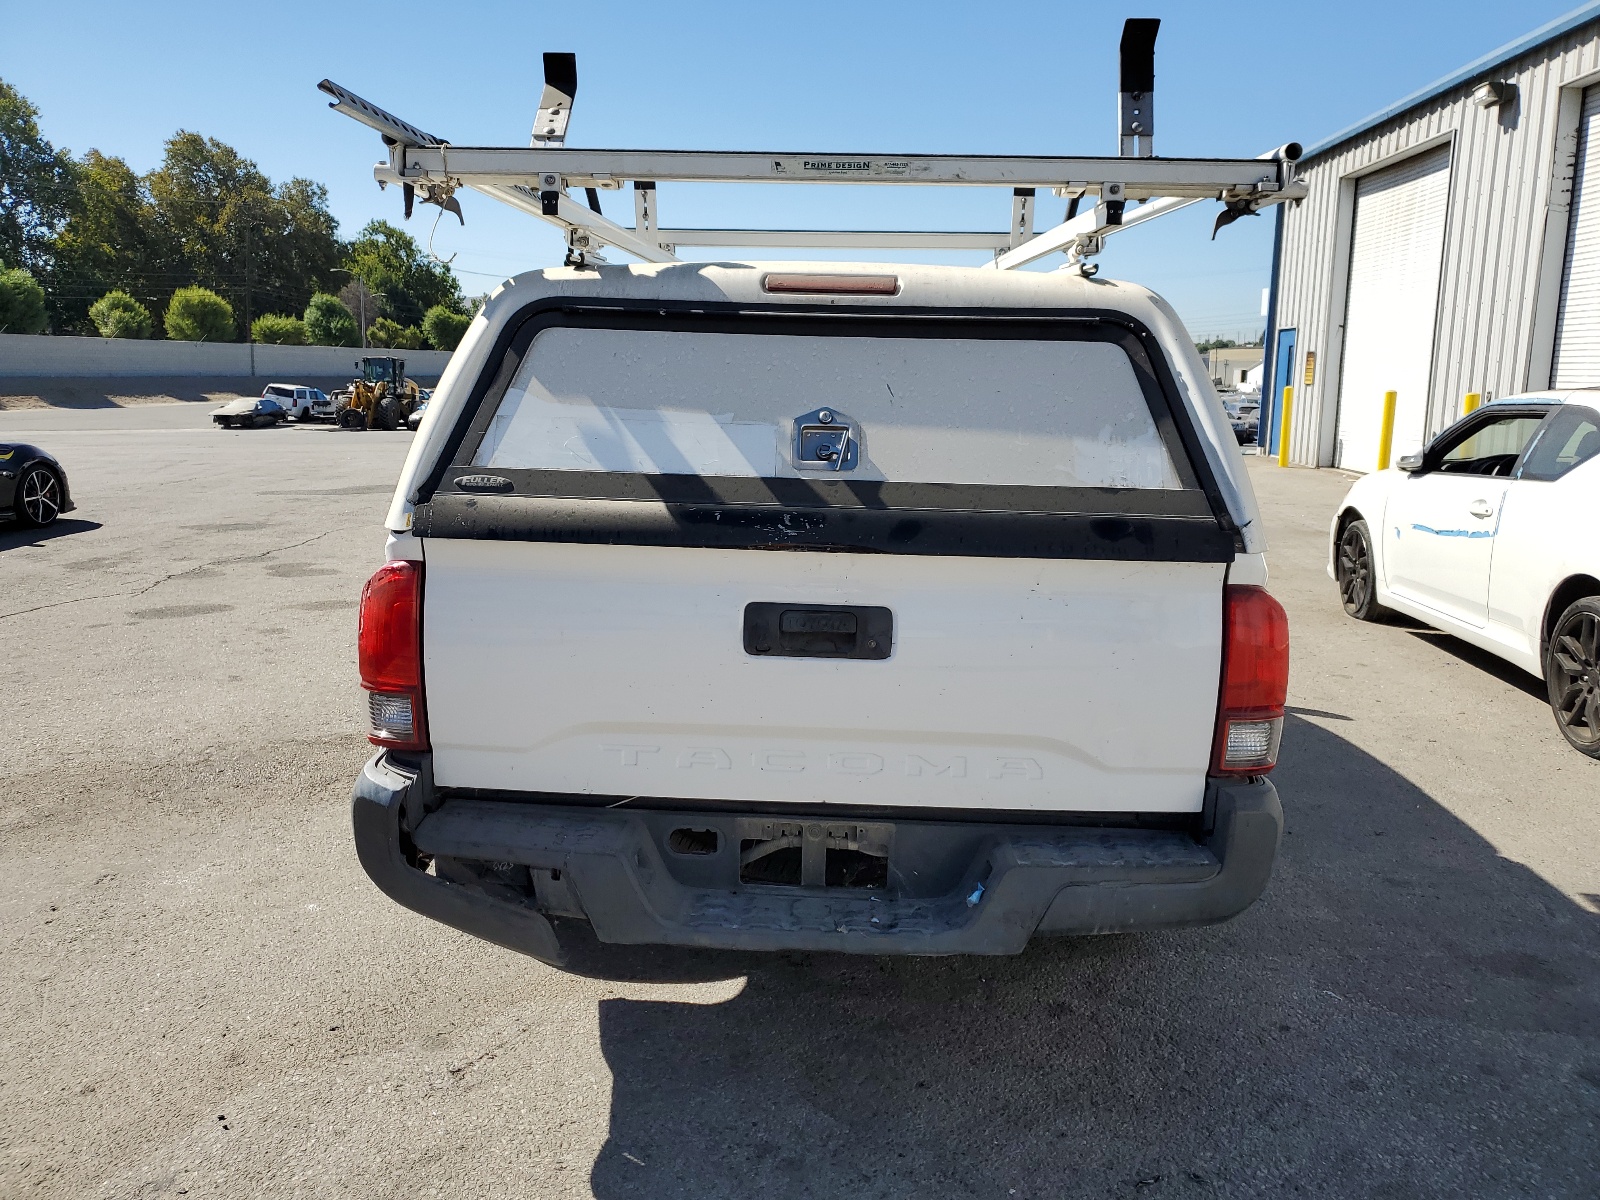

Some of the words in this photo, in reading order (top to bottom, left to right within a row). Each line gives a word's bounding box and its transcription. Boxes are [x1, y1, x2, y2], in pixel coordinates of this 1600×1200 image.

[803, 161, 833, 169] PRIME
[835, 161, 870, 169] DESIGN
[461, 476, 505, 486] FULLER
[598, 743, 1044, 782] TACOMA
